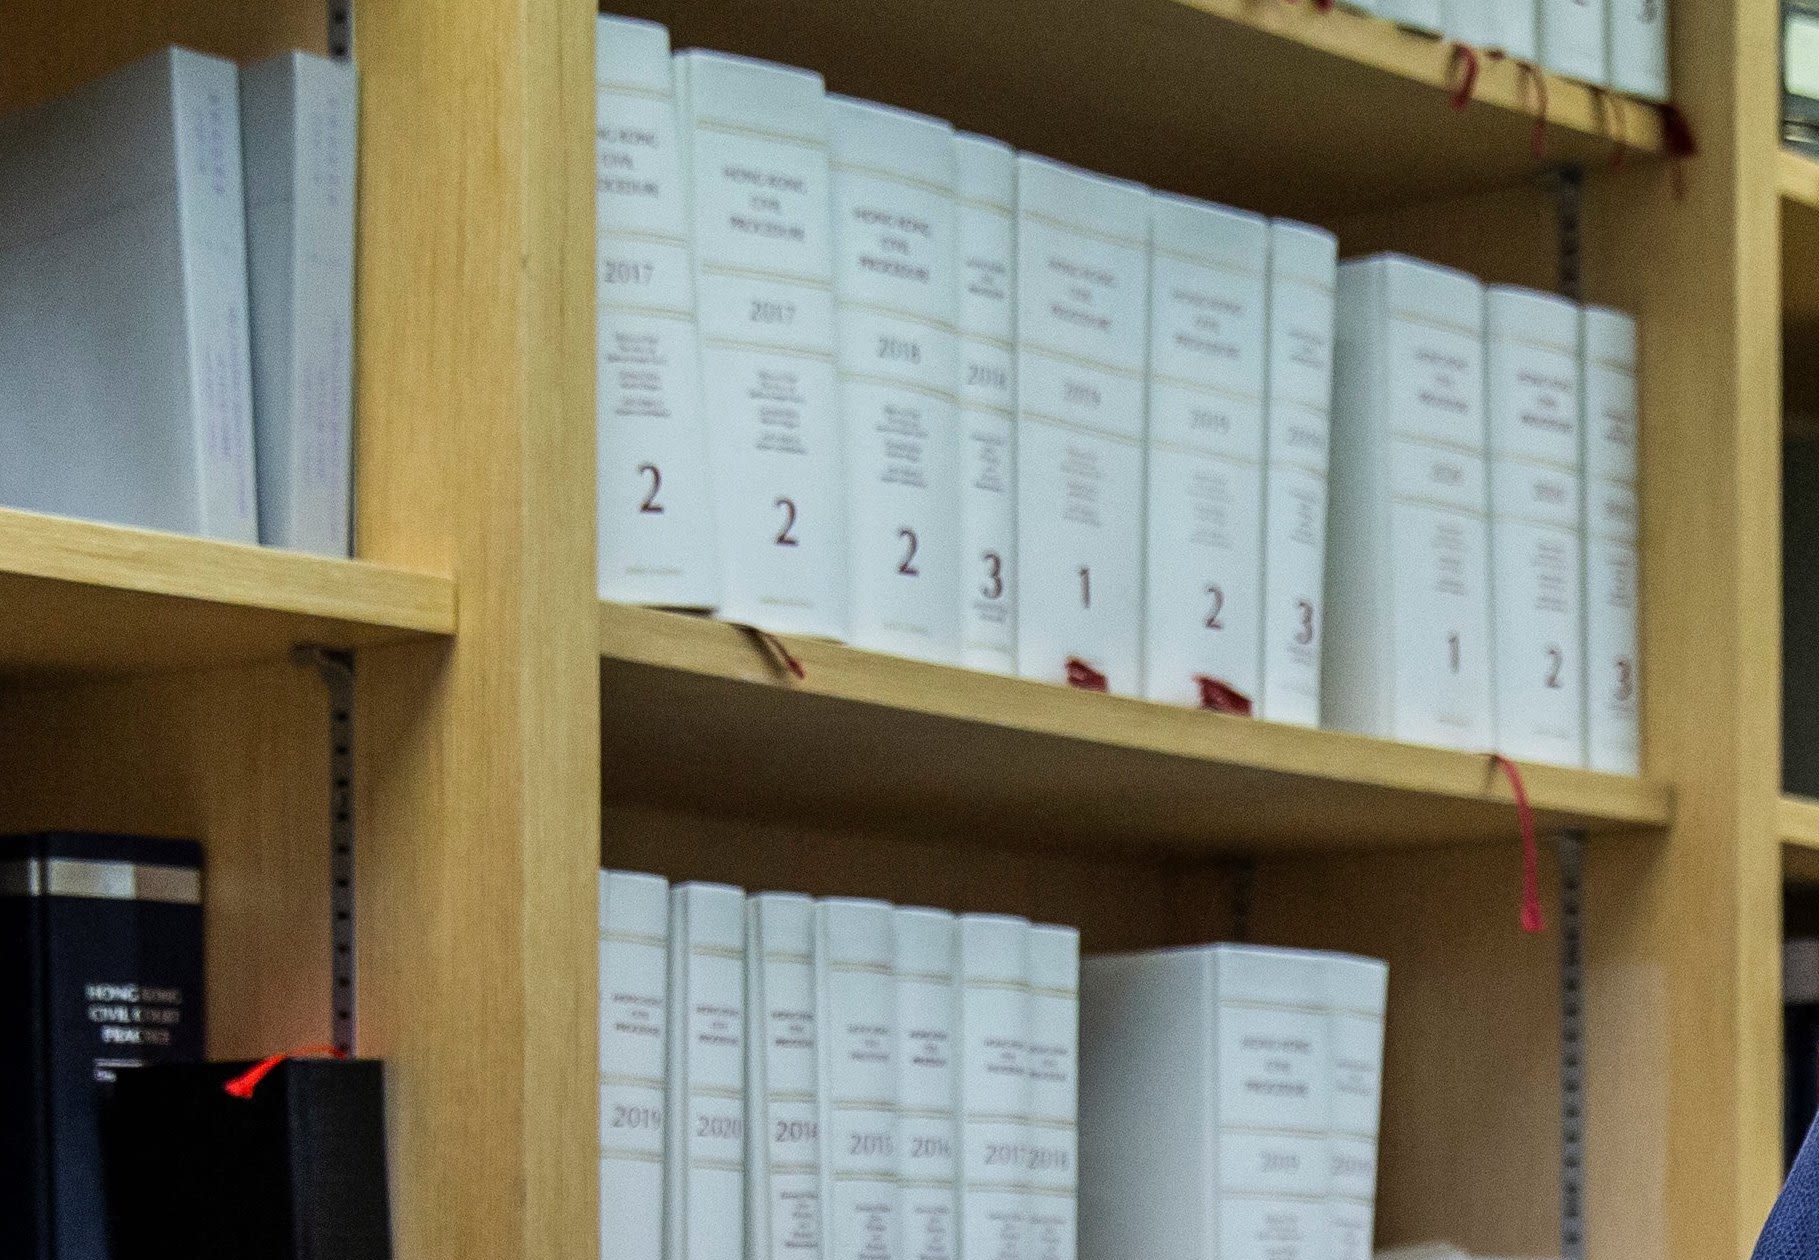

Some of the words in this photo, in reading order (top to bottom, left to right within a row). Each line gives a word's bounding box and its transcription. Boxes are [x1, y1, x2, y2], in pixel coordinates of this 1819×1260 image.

[604, 260, 654, 286] 2017
[637, 463, 665, 514] 2
[776, 497, 797, 546] 2
[896, 528, 919, 577] 2
[981, 552, 1003, 600] 3
[1079, 566, 1091, 610] 1
[1204, 582, 1225, 631] 2
[1295, 599, 1313, 645] 3
[1448, 634, 1460, 675] 1
[1544, 646, 1563, 689] 2
[611, 1104, 662, 1130] 2019
